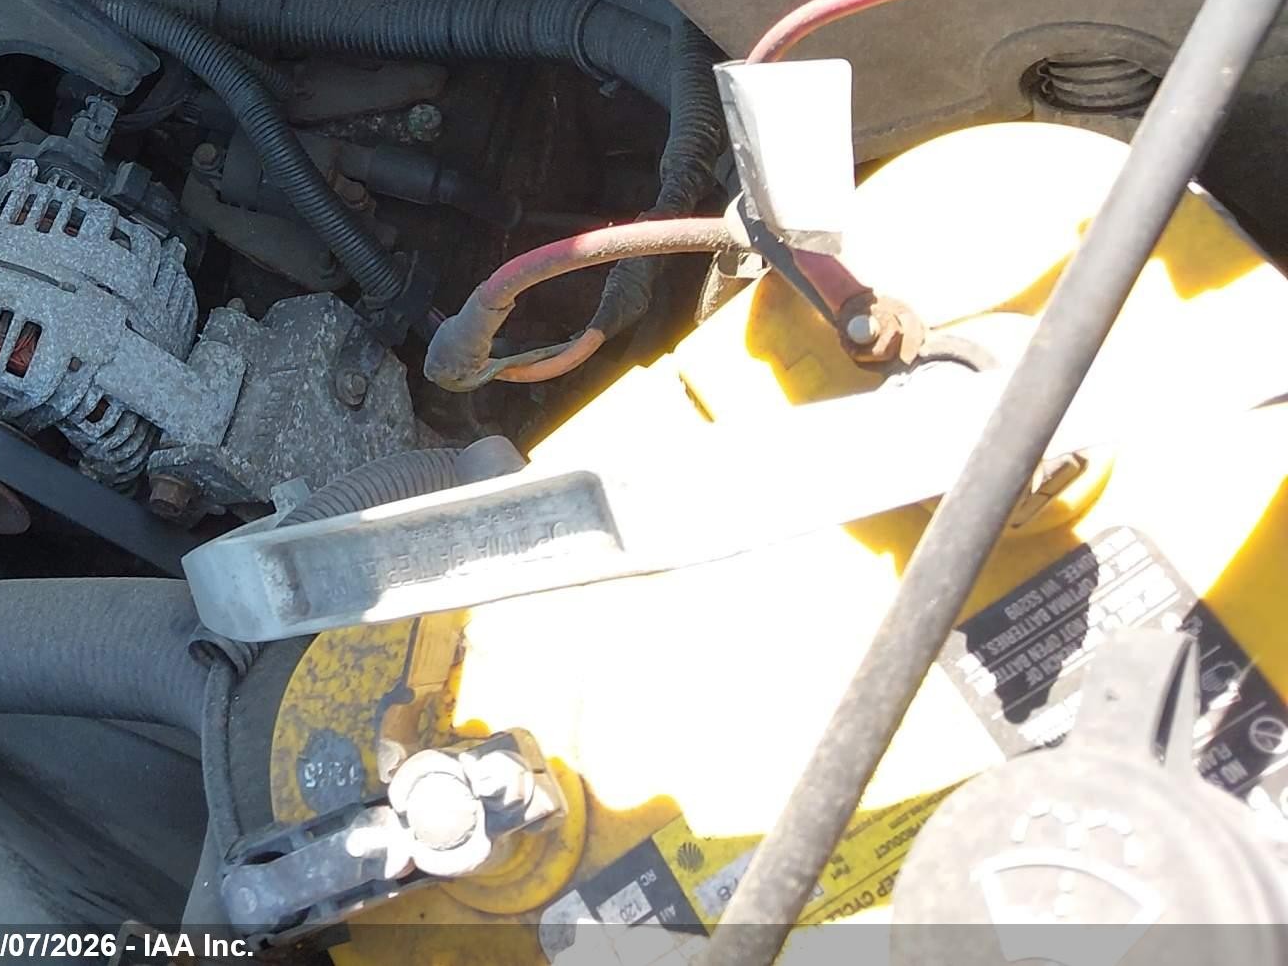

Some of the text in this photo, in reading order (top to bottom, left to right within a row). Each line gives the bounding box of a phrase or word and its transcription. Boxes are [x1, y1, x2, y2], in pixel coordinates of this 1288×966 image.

[1004, 590, 1042, 620] 53209
[1046, 577, 1094, 616] OPTIMA
[1059, 617, 1087, 642] NOT
[1026, 632, 1063, 662] OPEN
[1024, 665, 1044, 689] OF
[638, 869, 657, 887] RC
[618, 899, 644, 923] 120
[659, 904, 677, 922] AH
